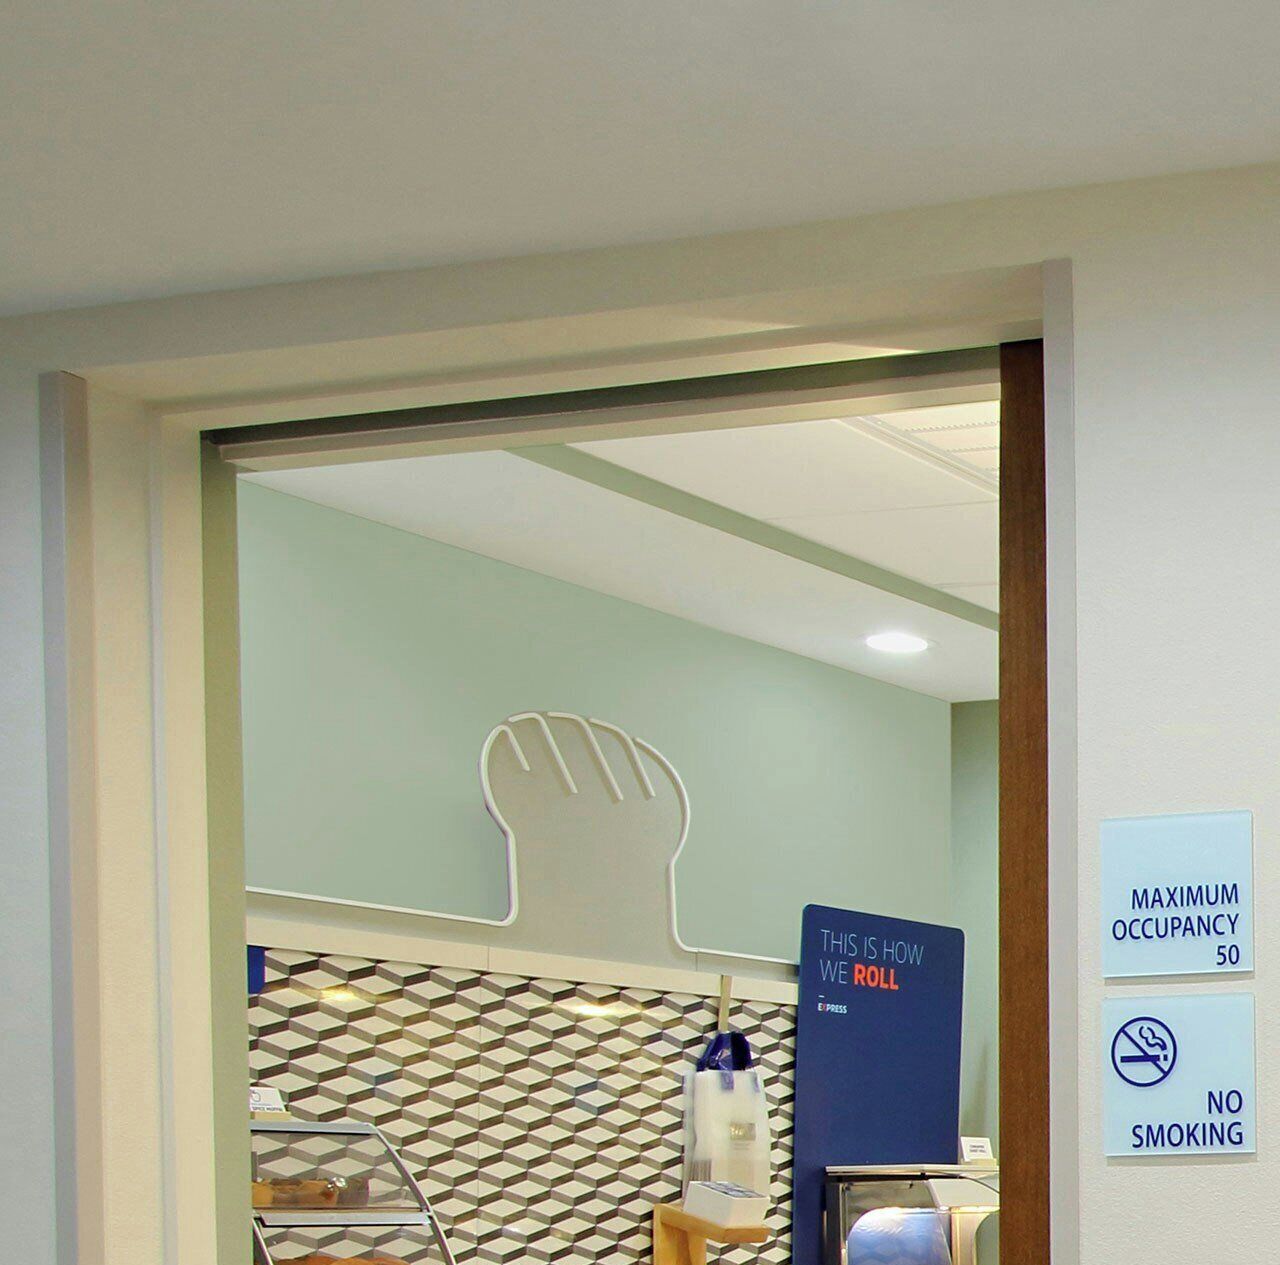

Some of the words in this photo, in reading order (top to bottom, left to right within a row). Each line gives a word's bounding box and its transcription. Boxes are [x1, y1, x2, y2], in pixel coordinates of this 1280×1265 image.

[1131, 883, 1239, 910] MAXIMUM
[1112, 913, 1240, 941] OCCUPANCY
[820, 929, 858, 957] THIS
[863, 936, 877, 960] IS
[883, 939, 924, 966] HOW
[1216, 944, 1240, 966] 50
[820, 958, 848, 984] WE
[854, 963, 899, 990] ROLL
[818, 1002, 848, 1014] EXPRESS
[1207, 1089, 1243, 1115] NO
[1131, 1121, 1244, 1149] SMOKING
